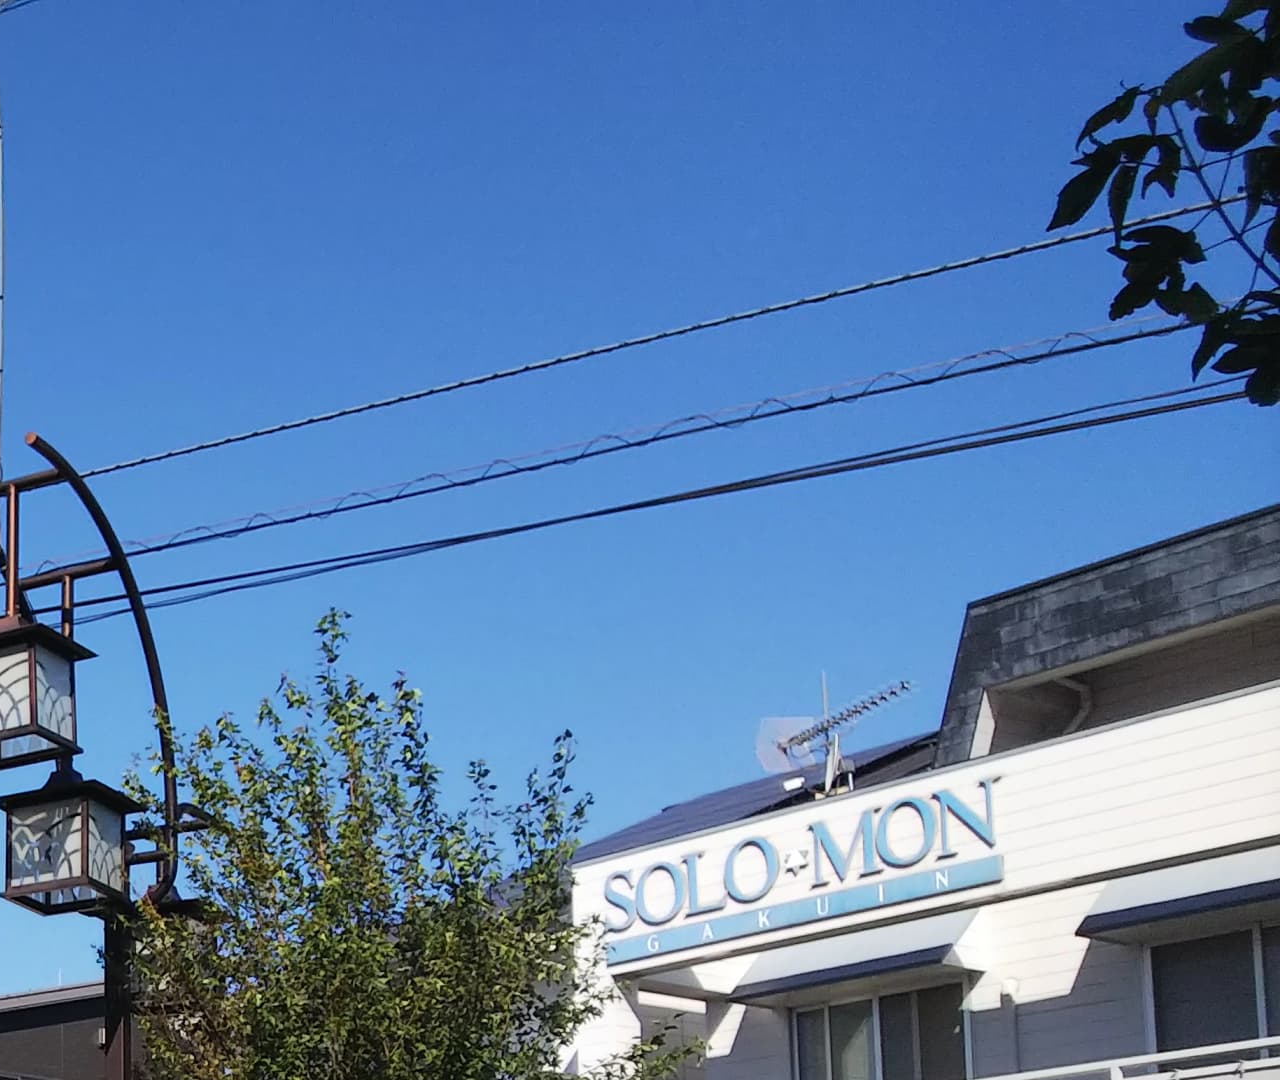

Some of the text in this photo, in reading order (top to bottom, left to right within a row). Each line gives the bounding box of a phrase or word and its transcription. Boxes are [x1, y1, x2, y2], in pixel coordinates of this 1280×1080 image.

[603, 776, 1001, 932] SOLO MON
[647, 870, 950, 952] GAKUIN
